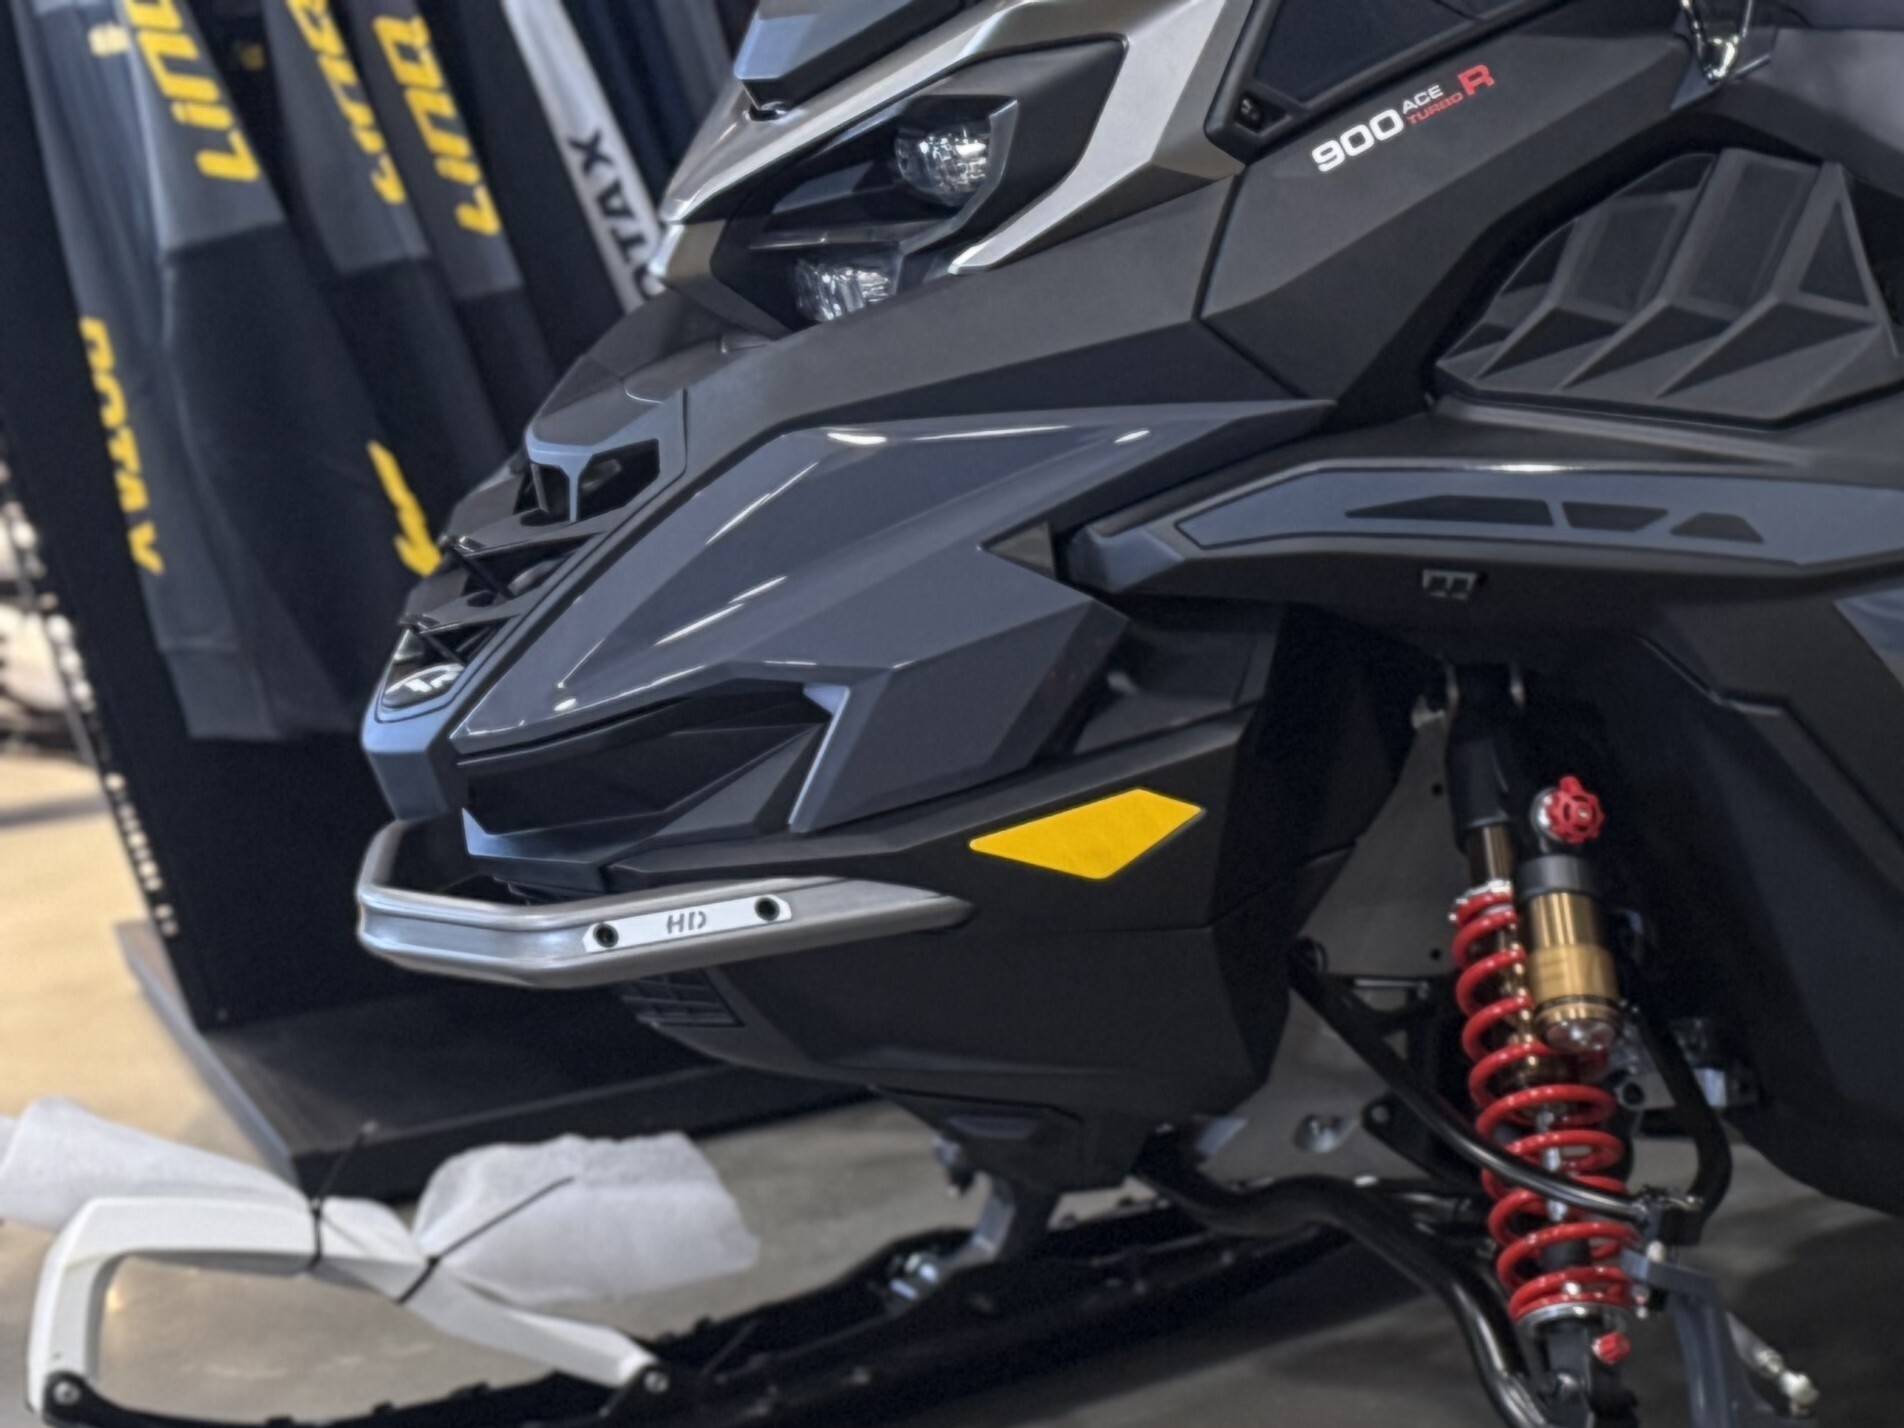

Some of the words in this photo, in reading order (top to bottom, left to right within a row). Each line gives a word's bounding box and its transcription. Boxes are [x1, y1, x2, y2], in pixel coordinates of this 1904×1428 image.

[1457, 64, 1496, 97] R
[1402, 84, 1444, 115] ACE
[1406, 92, 1464, 125] TURBO
[1311, 108, 1405, 172] 900
[666, 910, 707, 935] HD
